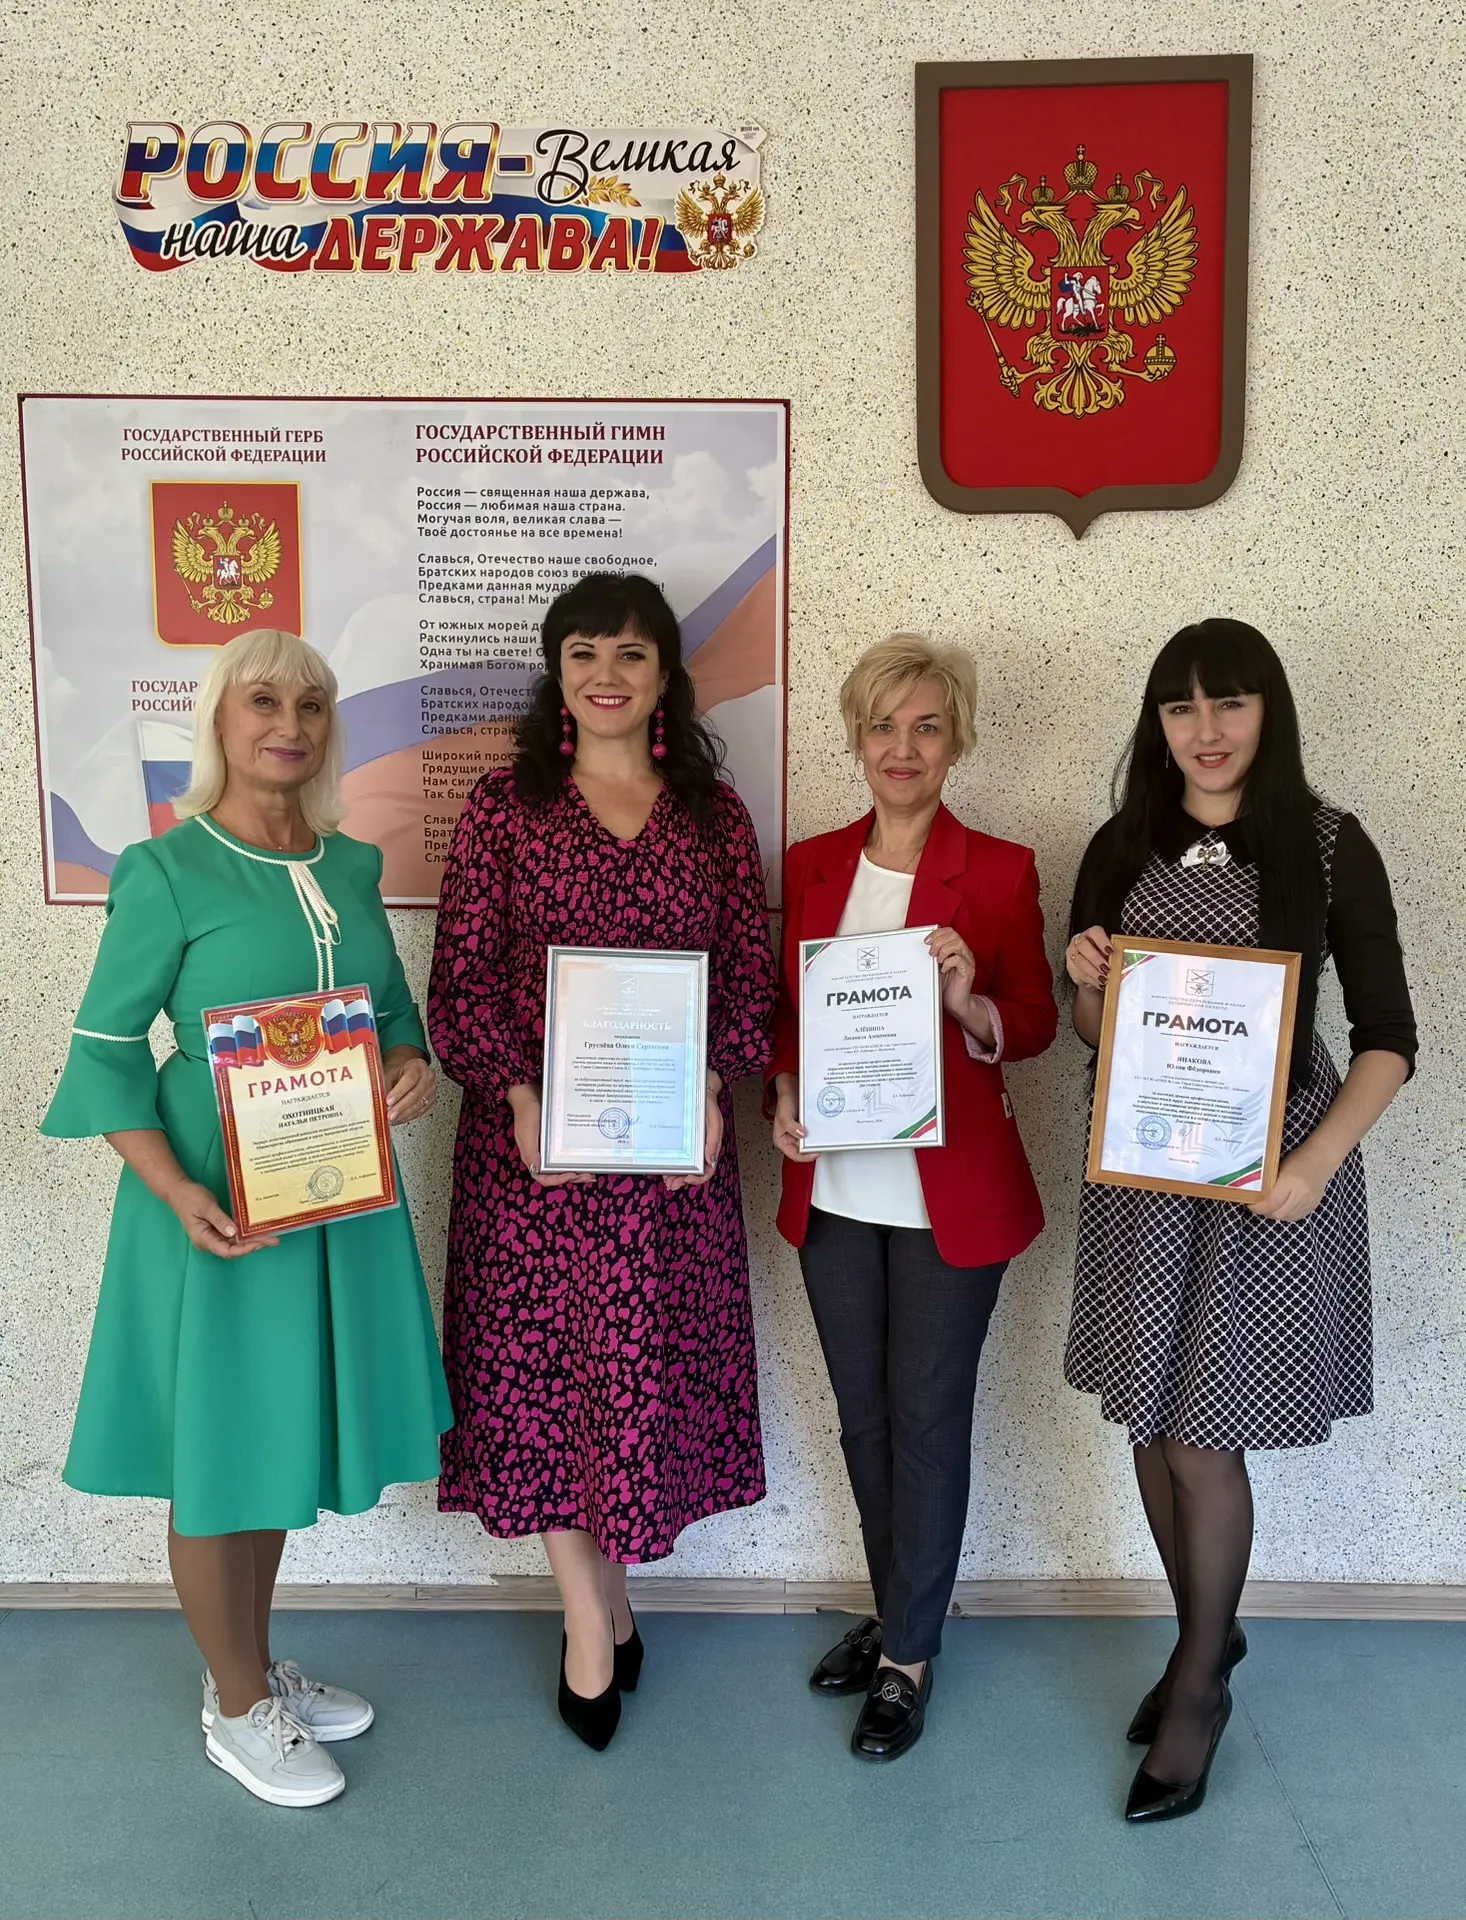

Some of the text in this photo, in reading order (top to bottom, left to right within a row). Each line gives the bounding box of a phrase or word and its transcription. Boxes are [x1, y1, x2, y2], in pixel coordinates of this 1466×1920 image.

[535, 130, 741, 204] Великая
[160, 215, 664, 272] наша ДЕРЖАВА!
[123, 427, 324, 444] ГОСУДАРСТВЕННЫЙ ГЕРБ
[415, 422, 665, 443] ГОСУДАРСТВЕННЫЙ ГИМН
[121, 446, 326, 464] РОССИЙСКОЙ ФЕДЕРАЦИИ
[416, 445, 664, 467] РОССИЙСКОЙ ФЕДЕРАЦИИ
[417, 486, 461, 498] Россия
[480, 489, 550, 499] священная
[553, 489, 586, 498] наша
[590, 489, 650, 500] держава,
[417, 500, 461, 511] Россия
[480, 500, 539, 511] любимая
[543, 502, 575, 511] наша
[579, 502, 626, 514] страна.
[417, 514, 471, 526] Могучая
[475, 516, 509, 526] воля,
[513, 516, 566, 525] великая
[569, 516, 605, 525] слава
[417, 526, 623, 540] Твоё достоянье на все времена!
[418, 554, 658, 567] Славься, Отечество наше свободное,
[418, 567, 476, 579] Братских
[480, 569, 534, 579] народов
[537, 569, 569, 578] союз
[418, 580, 576, 593] Предками данная мудро
[418, 594, 474, 606] Славься,
[478, 594, 525, 607] страна!
[528, 594, 549, 604] Мы
[419, 619, 435, 630] От
[439, 621, 484, 631] южных
[488, 620, 528, 632] морей
[419, 633, 500, 645] Раскинулись
[504, 635, 537, 643] наши
[420, 646, 452, 657] Одна
[456, 648, 471, 656] ты
[474, 648, 489, 657] на
[493, 647, 532, 657] свете!
[420, 659, 483, 671] Хранимая
[487, 660, 526, 670] Богом
[131, 680, 201, 695] ГОСУДАР
[421, 685, 476, 697] Славься,
[132, 696, 196, 711] РОССИЙ
[421, 698, 479, 710] Братских
[421, 711, 485, 723] Предками
[422, 724, 477, 736] Славься,
[422, 750, 481, 762] Широкий
[422, 763, 485, 775] Грядущие
[423, 776, 448, 786] Нам
[423, 789, 444, 799] Так
[424, 828, 453, 839] Брат
[425, 841, 448, 851] Пре
[425, 853, 448, 863] Сла
[826, 985, 913, 1007] ГРАМОТА
[1142, 1011, 1249, 1037] ГРАМОТА
[1174, 1041, 1219, 1051] НАГРАЖДАЕТСЯ
[248, 1066, 354, 1098] ГРАМОТА
[281, 1091, 331, 1106] НАГРАЖДАЕТСЯ
[282, 1105, 335, 1120] ОХОТНИЦКАЯ
[309, 1111, 344, 1124] ПЕТРОВНА
